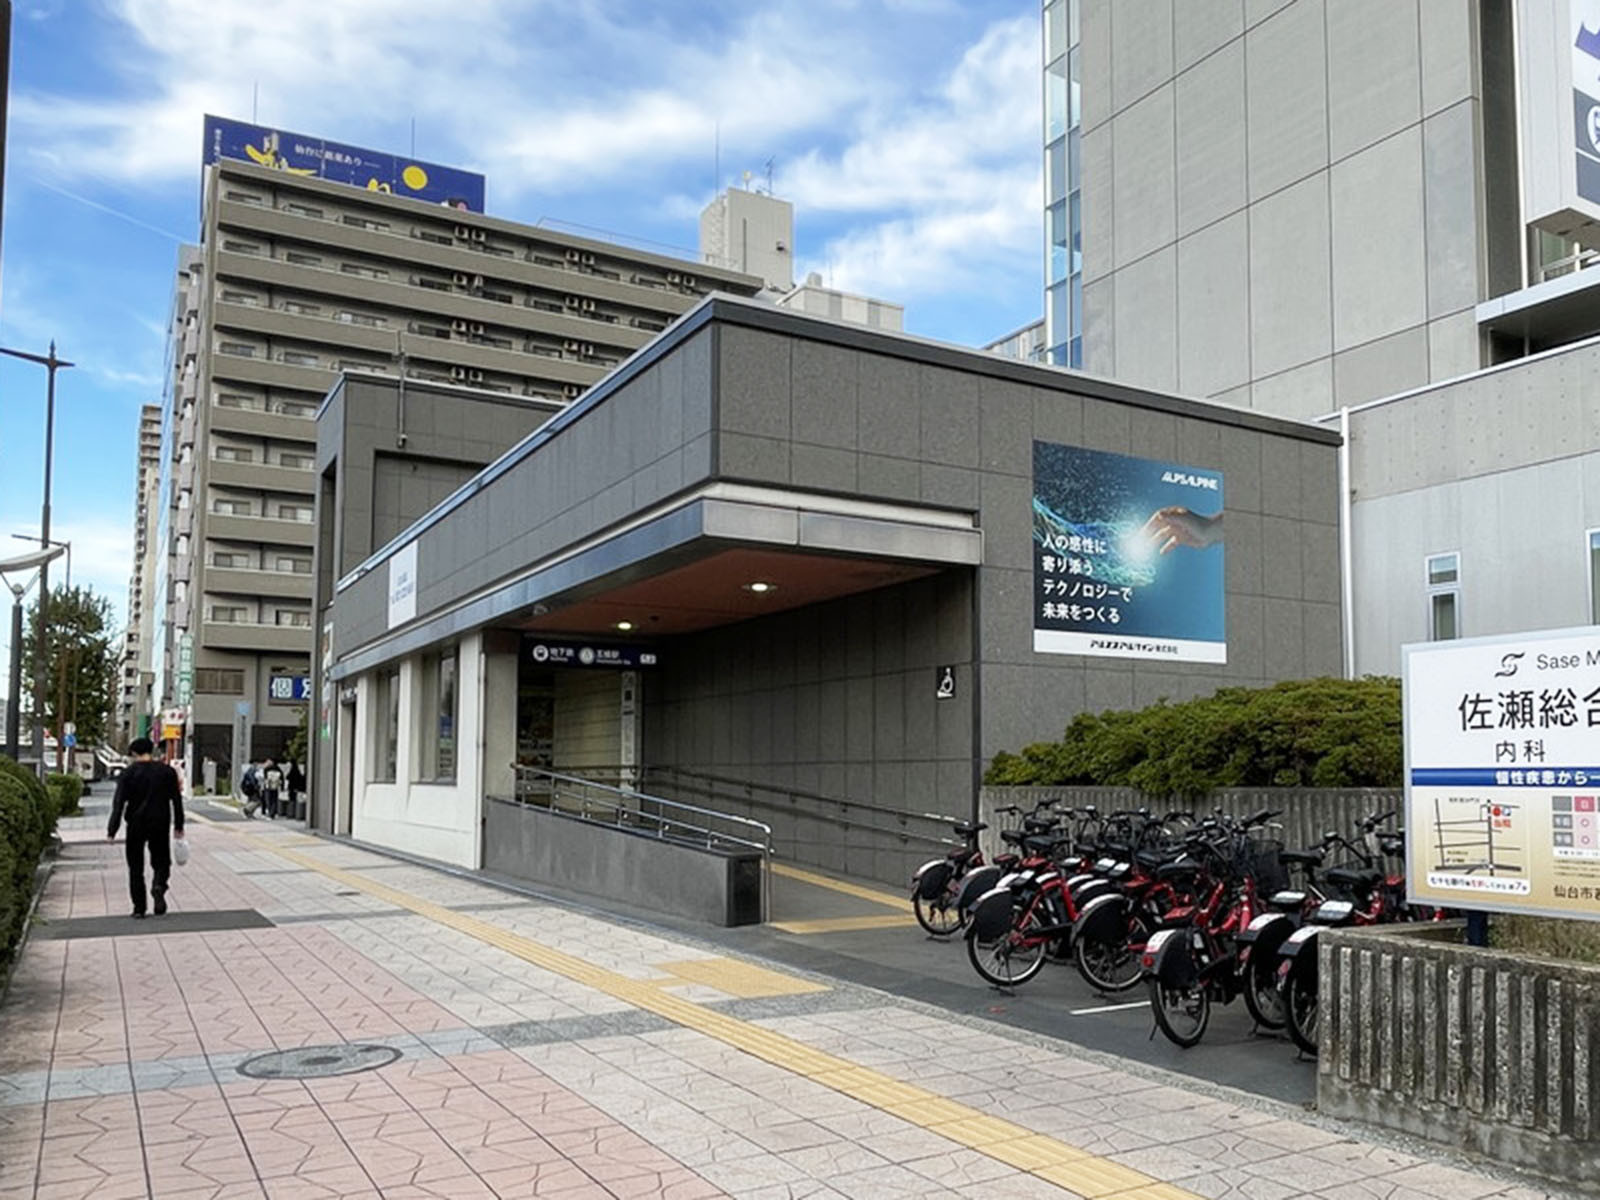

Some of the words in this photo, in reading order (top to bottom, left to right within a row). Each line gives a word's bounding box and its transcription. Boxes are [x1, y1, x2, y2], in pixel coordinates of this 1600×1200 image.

[1042, 533, 1107, 554] 人の感性に
[1042, 555, 1094, 576] 寄り添う
[1043, 578, 1133, 602] テクノロジーで
[1042, 601, 1121, 624] 未来をつくる
[1536, 653, 1581, 671] Sase
[1495, 739, 1546, 763] 内科
